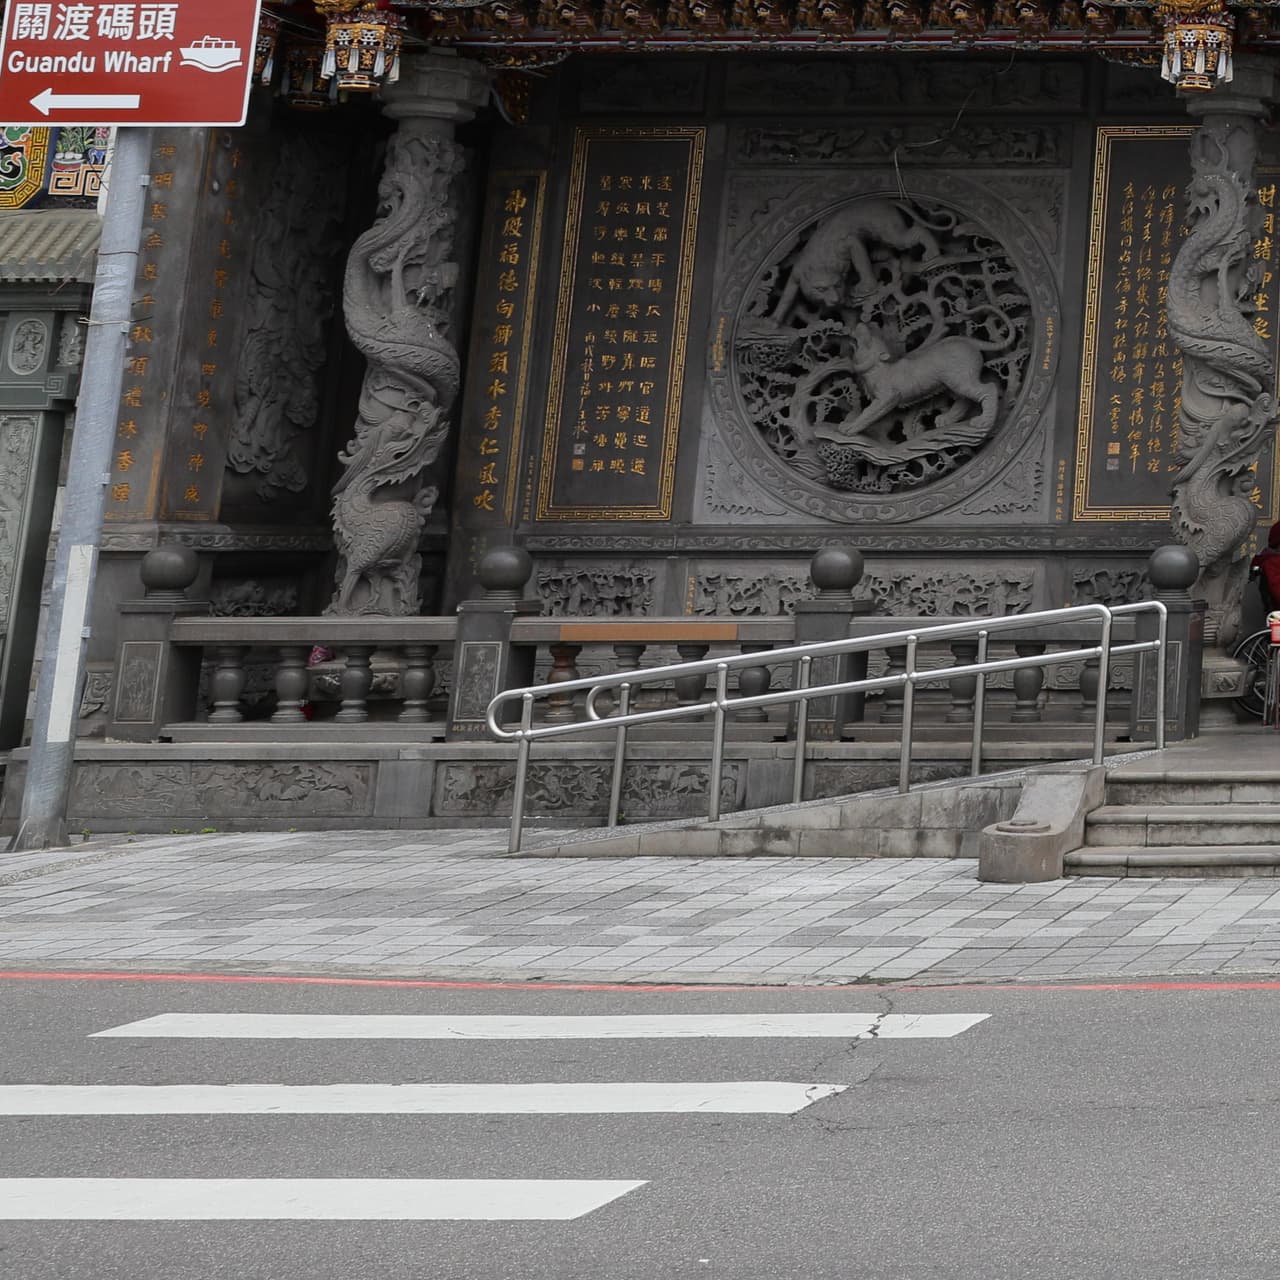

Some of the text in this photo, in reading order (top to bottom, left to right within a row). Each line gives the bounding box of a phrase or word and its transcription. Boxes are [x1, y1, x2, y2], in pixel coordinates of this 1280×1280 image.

[11, 3, 179, 41] 關渡碼頭
[8, 51, 173, 73] Guandu Wharf
